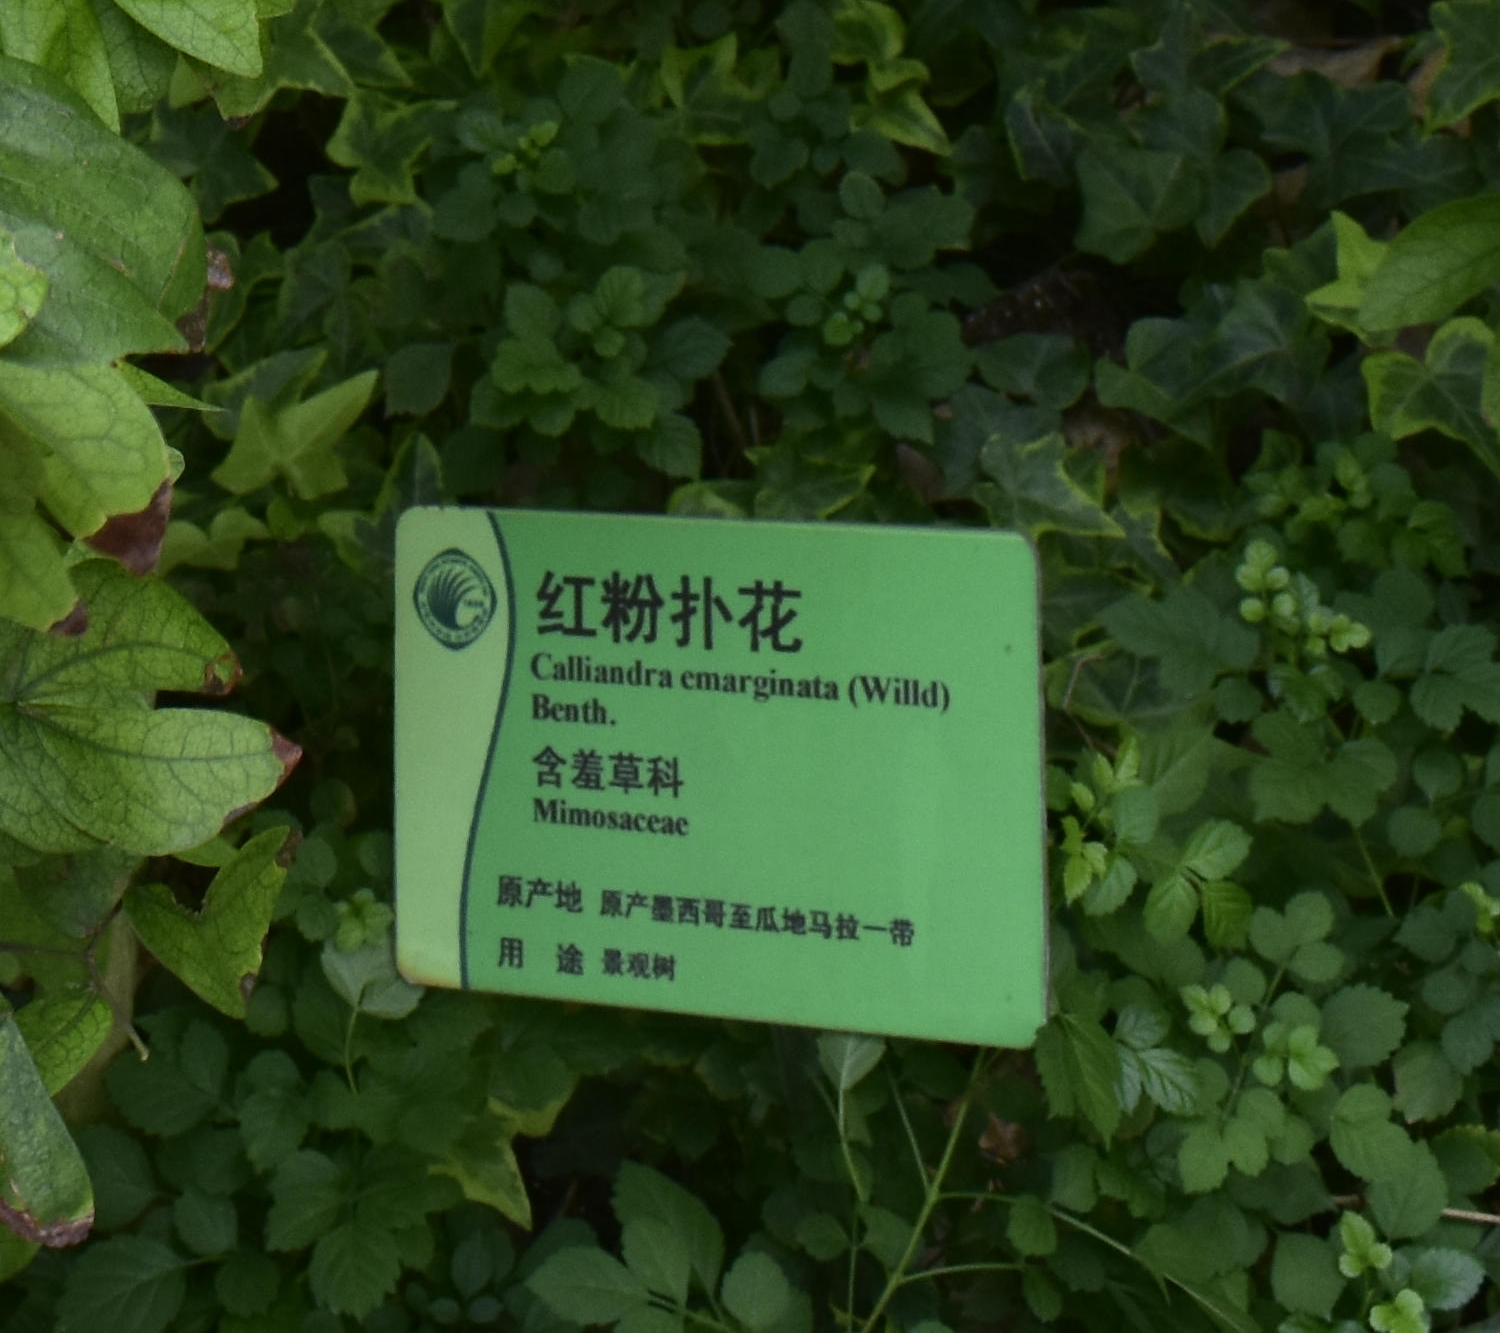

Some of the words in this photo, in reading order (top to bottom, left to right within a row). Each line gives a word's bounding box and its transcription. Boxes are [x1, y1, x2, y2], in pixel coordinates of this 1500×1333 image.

[536, 571, 803, 653] 红粉扑花
[530, 652, 673, 690] Calliandra
[680, 667, 840, 702] emarginata
[848, 675, 951, 714] (Willd)
[531, 693, 617, 726] Benth.
[532, 745, 684, 798] 含羞草科
[533, 797, 689, 836] Mimosaceae
[497, 874, 583, 914] 原产地
[600, 889, 916, 948] 原产墨西哥至瓜地马拉一带
[602, 948, 675, 982] 景观树
